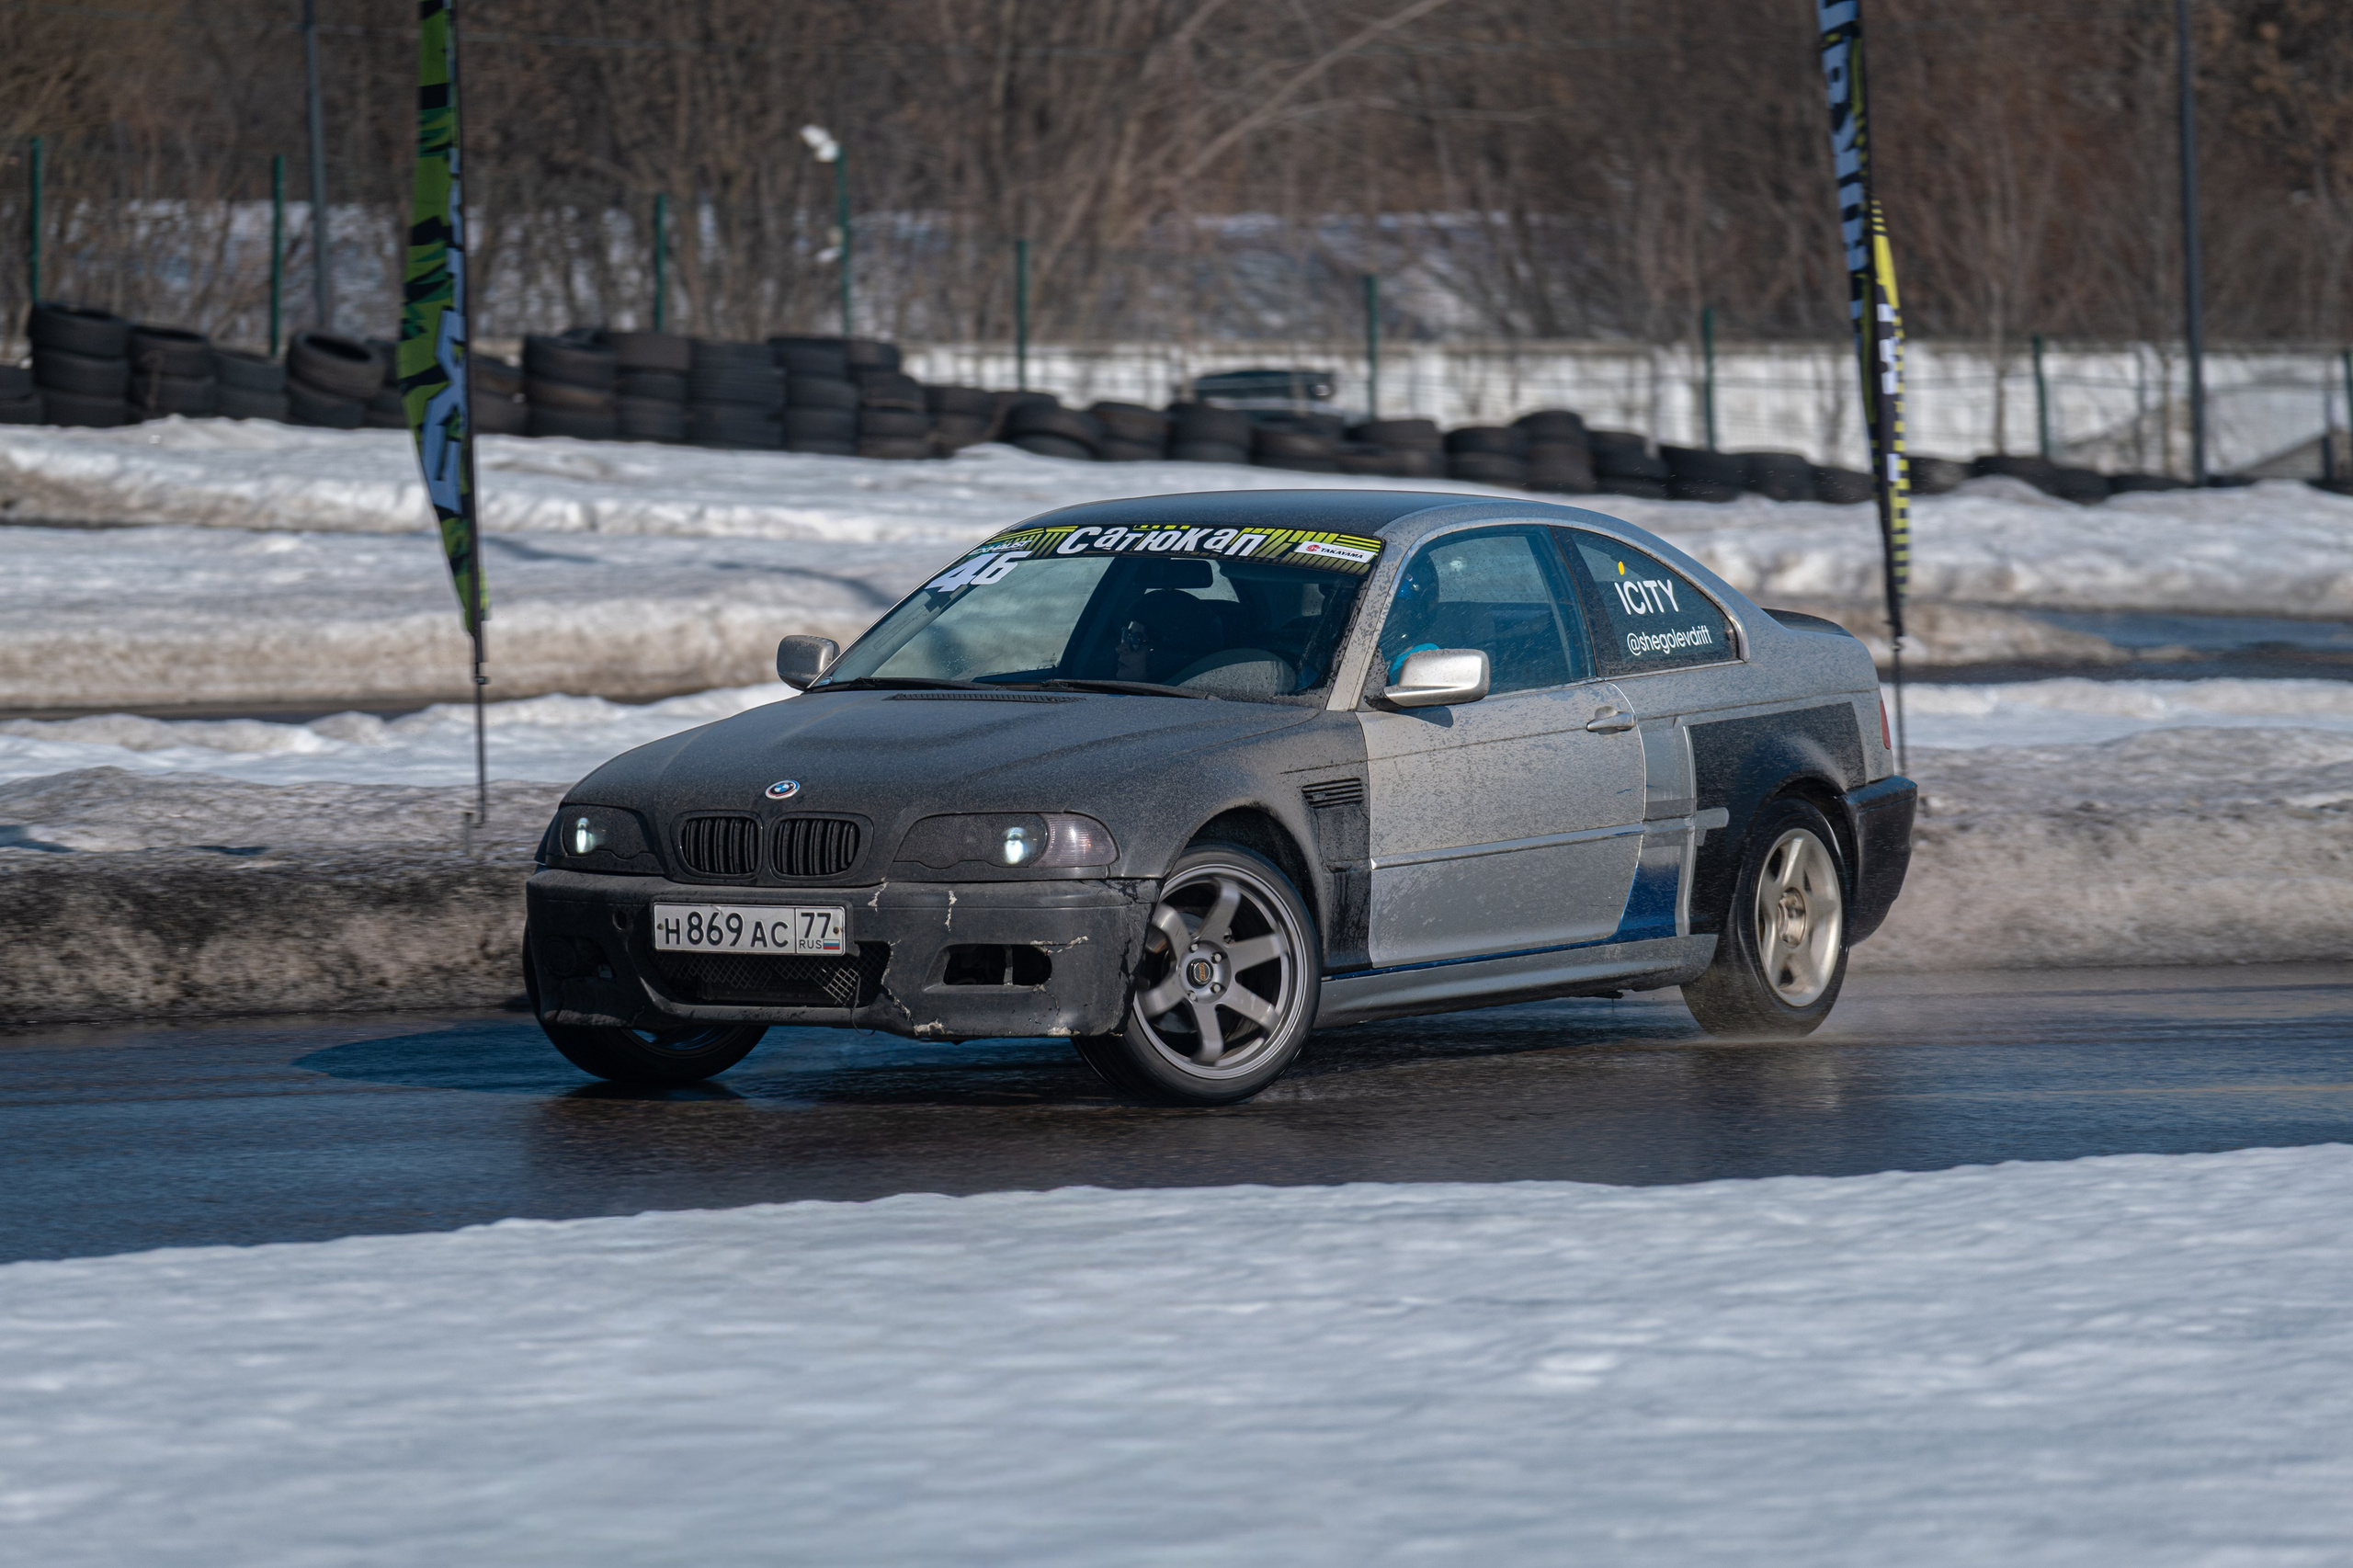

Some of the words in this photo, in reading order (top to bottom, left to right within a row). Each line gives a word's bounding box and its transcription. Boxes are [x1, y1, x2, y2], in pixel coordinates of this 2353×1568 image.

[1321, 547, 1364, 560] TAKAYAMA
[925, 551, 1033, 593] 46
[1626, 625, 1712, 656] @shegolevdrift
[801, 912, 832, 938] 77
[799, 939, 823, 949] RUS
